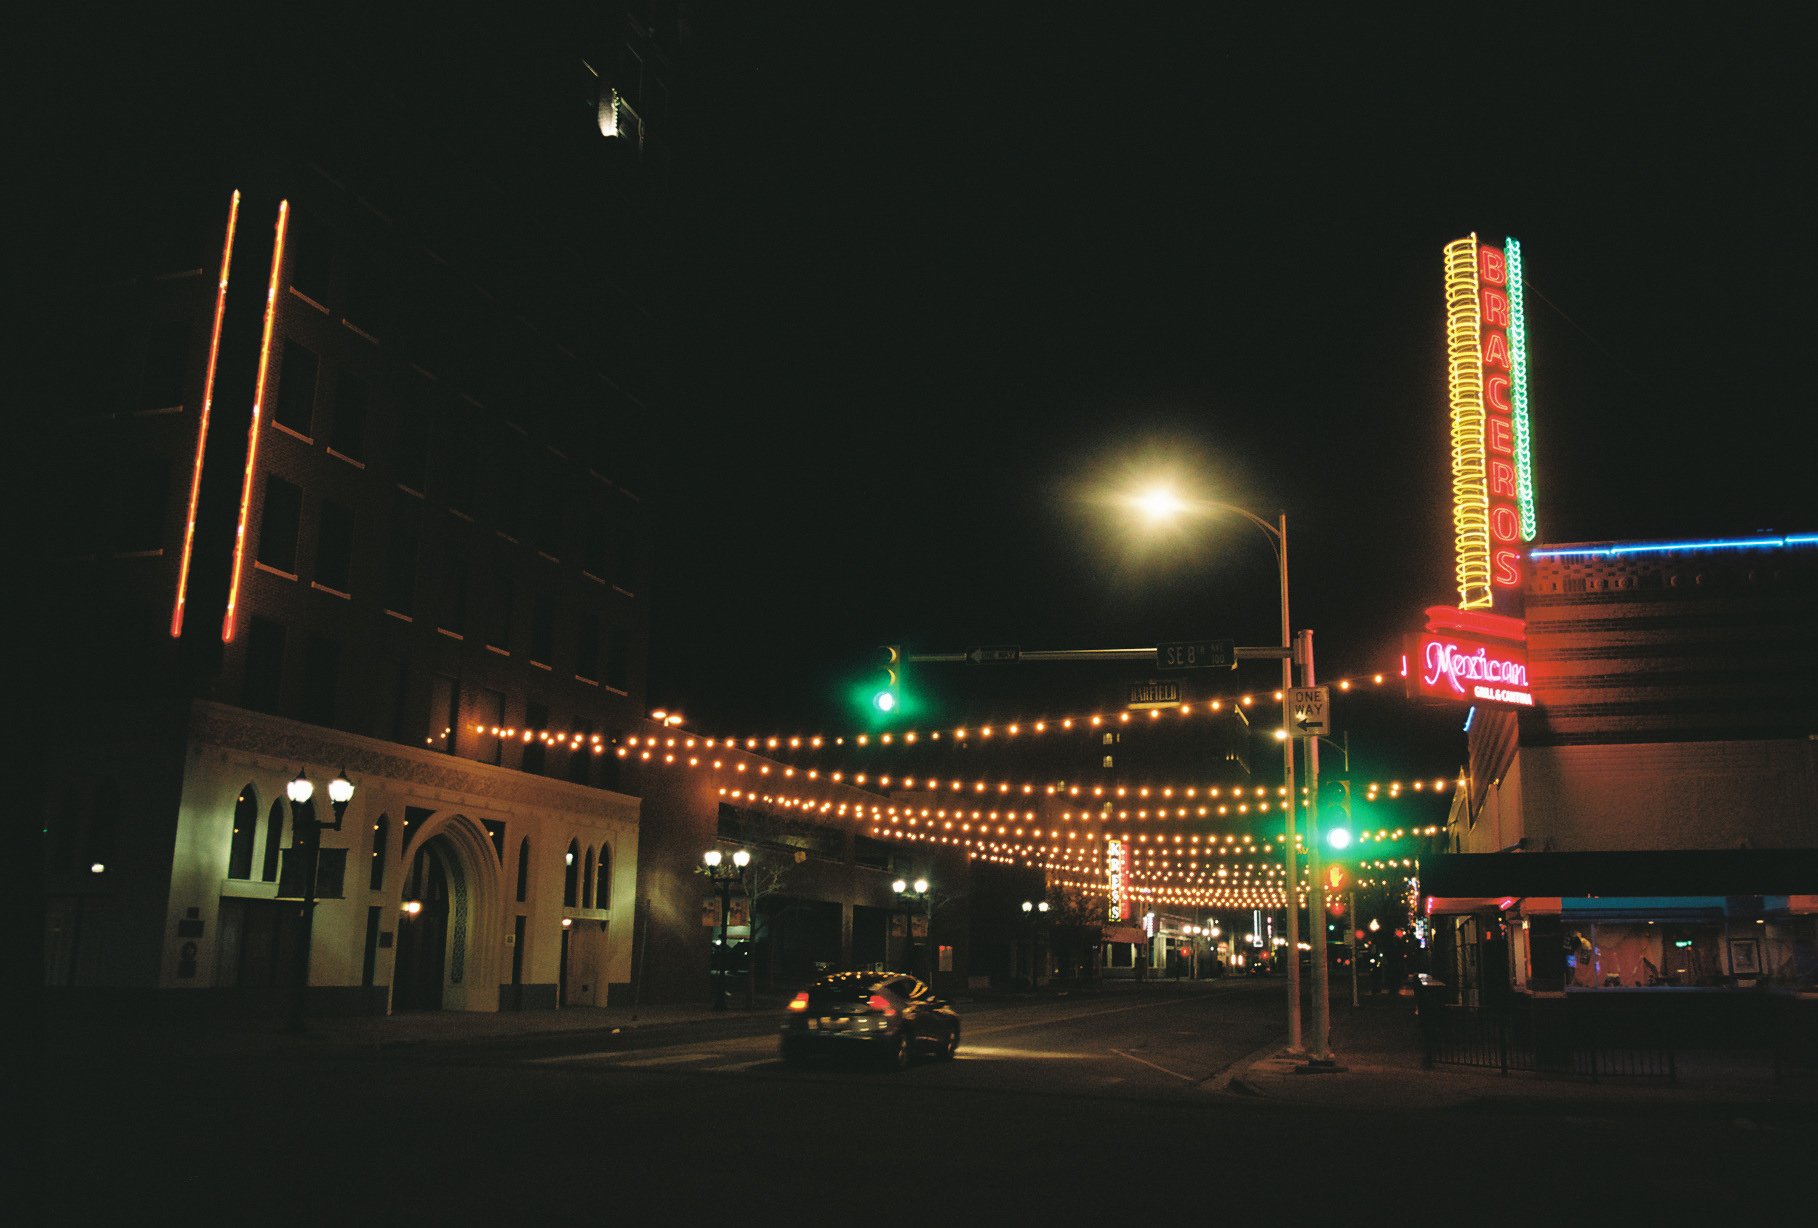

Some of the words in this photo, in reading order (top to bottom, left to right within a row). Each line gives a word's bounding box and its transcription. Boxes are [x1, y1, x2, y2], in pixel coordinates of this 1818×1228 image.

[1481, 250, 1519, 585] BRACEROS
[1167, 646, 1184, 665] SE
[1210, 642, 1224, 653] AVE
[1425, 642, 1529, 693] Mexican
[1295, 690, 1322, 703] ONE
[1474, 685, 1495, 700] GRILL
[1501, 689, 1533, 705] CANTINA
[1295, 703, 1322, 715] WAY
[1110, 842, 1120, 919] KRESS
